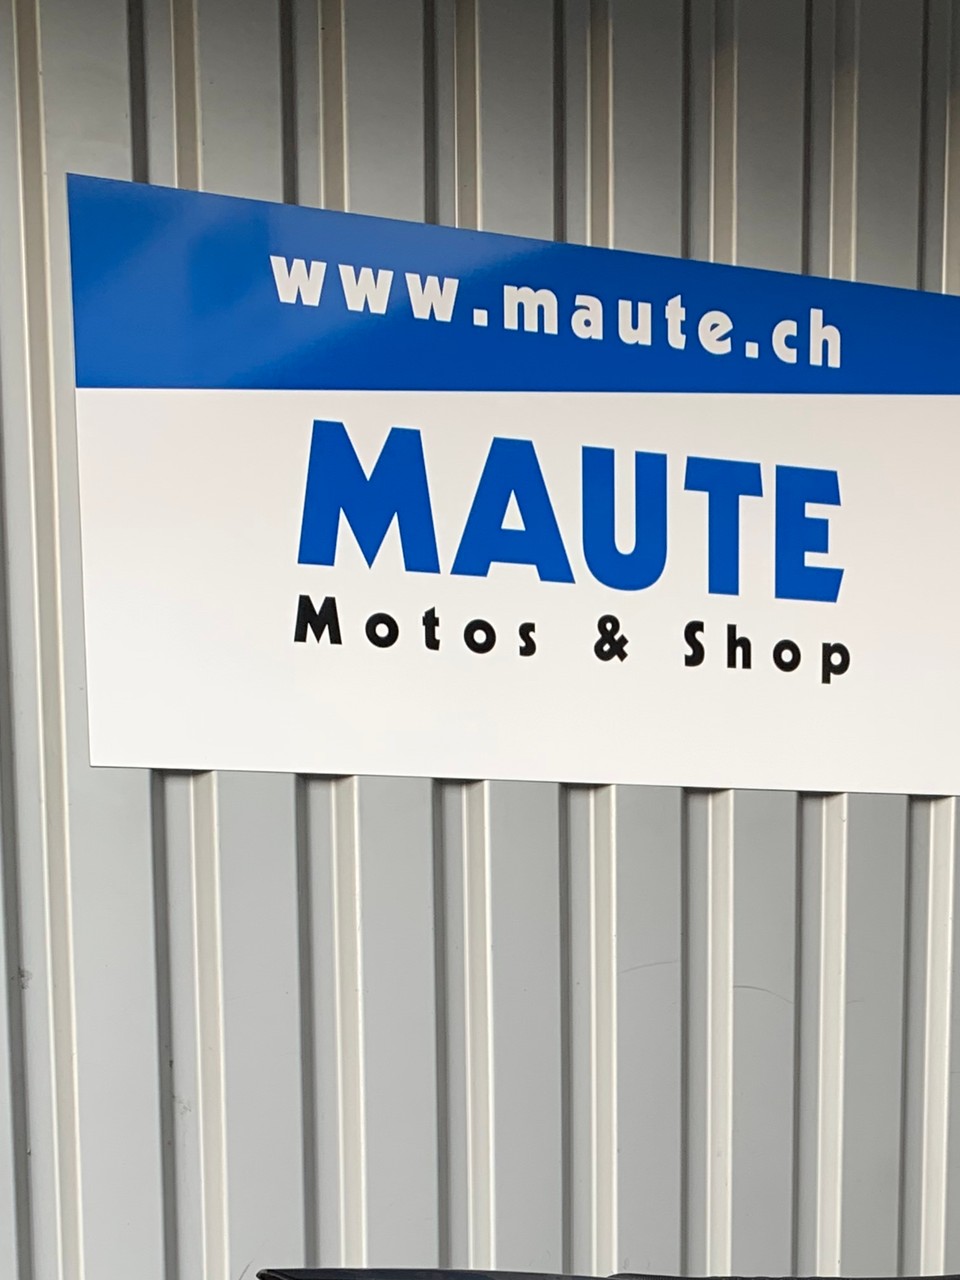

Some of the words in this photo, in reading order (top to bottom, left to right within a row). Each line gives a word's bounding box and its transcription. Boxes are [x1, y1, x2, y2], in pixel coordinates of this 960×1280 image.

[270, 255, 843, 368] www.maute.ch
[298, 419, 844, 603] MAUTE
[294, 595, 537, 657] Motos
[594, 615, 629, 662] &
[684, 621, 851, 685] Shop
